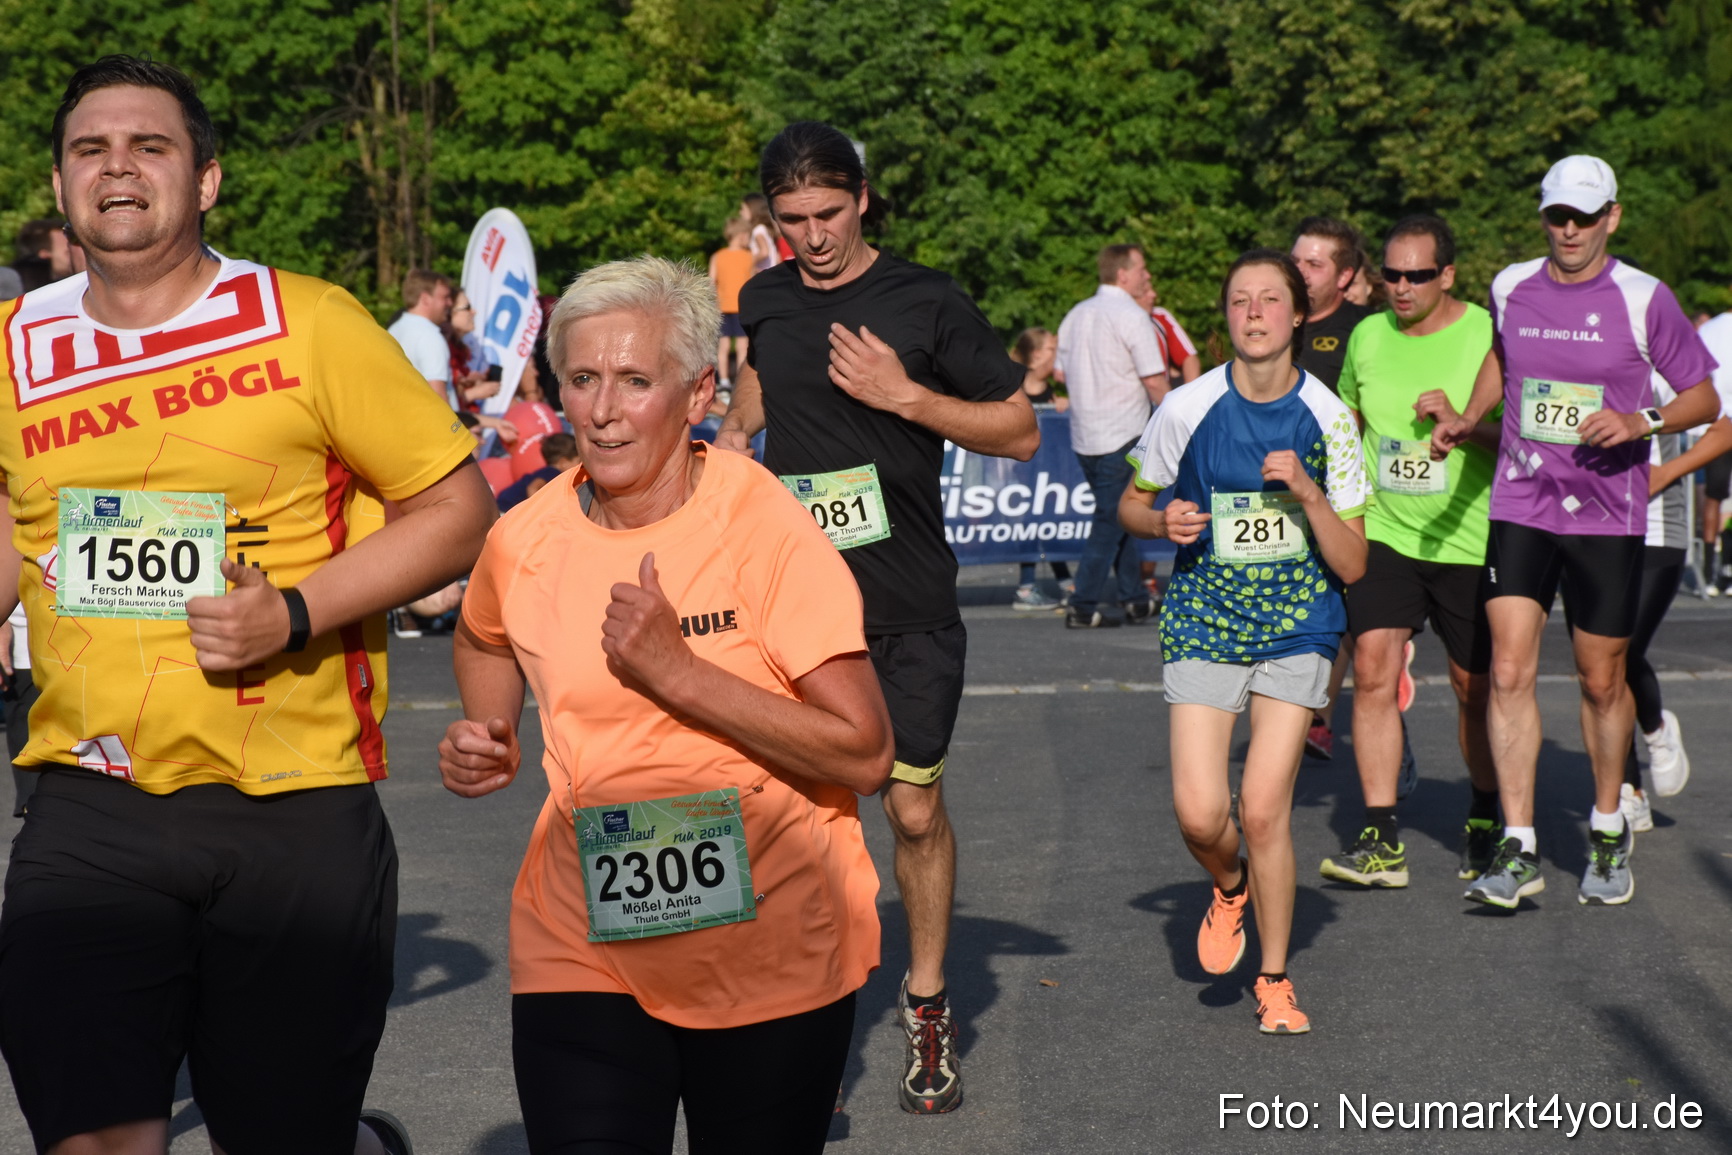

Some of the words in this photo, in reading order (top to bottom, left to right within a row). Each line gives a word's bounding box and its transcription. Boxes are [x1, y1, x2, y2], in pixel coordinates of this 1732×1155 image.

[480, 226, 500, 267] AVIA
[1519, 327, 1540, 338] WIR
[1542, 329, 1570, 340] SIND
[1572, 330, 1604, 342] LILA.
[20, 395, 140, 459] MAX
[153, 358, 302, 420] BÖGL
[1535, 402, 1579, 427] 878
[1389, 459, 1430, 479] 452
[854, 486, 873, 495] 2019
[808, 496, 867, 530] 081
[83, 514, 144, 528] firmenlauf
[157, 527, 178, 537] run
[182, 528, 214, 538] 2019
[840, 523, 872, 535] Thomas
[1234, 517, 1284, 543] 281
[1258, 542, 1291, 551] Christina
[78, 536, 200, 584] 1560
[91, 584, 132, 596] Fersch
[136, 586, 184, 598] Markus
[79, 597, 96, 605] Max
[97, 597, 116, 608] Bögl
[118, 599, 166, 608] Bauservice
[596, 825, 656, 844] firmenlauf
[674, 831, 695, 843] run
[700, 825, 731, 840] 2019
[595, 841, 725, 902] 2306
[622, 899, 661, 915] Mößel
[666, 895, 702, 909] Anita
[634, 914, 659, 925] Thule
[661, 909, 691, 921] GmbH
